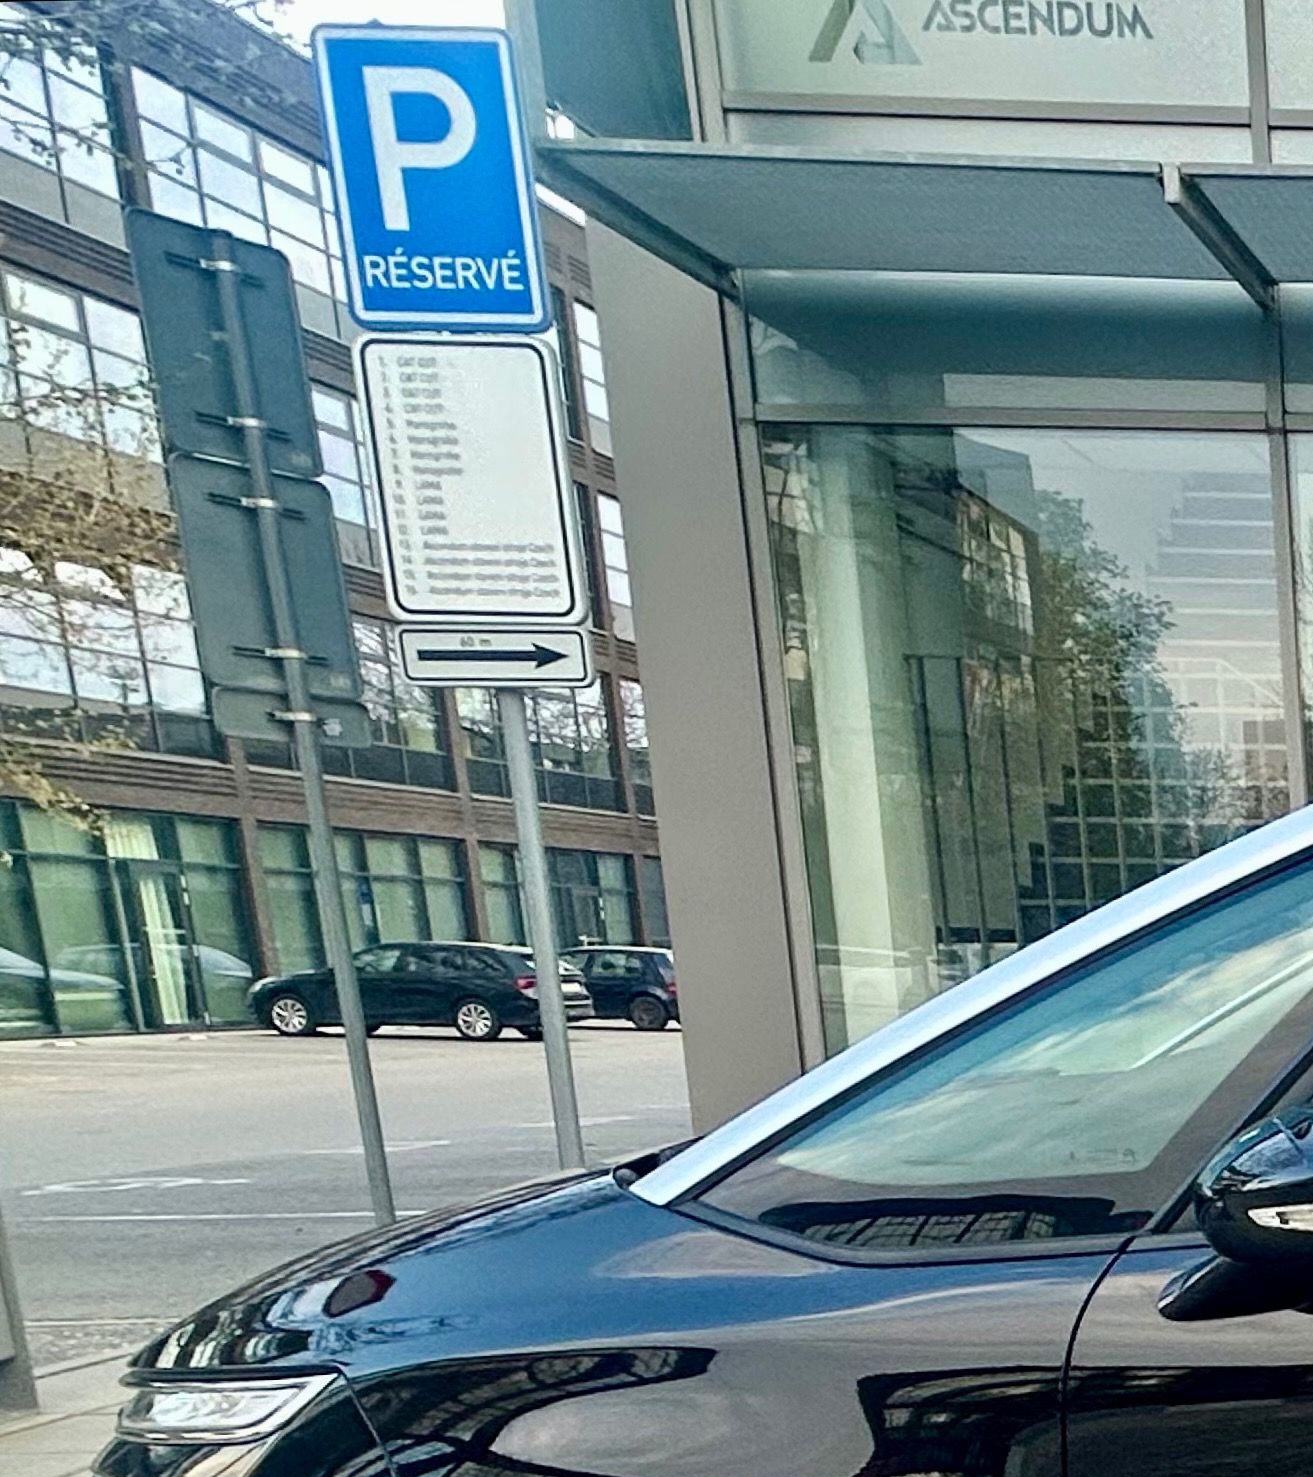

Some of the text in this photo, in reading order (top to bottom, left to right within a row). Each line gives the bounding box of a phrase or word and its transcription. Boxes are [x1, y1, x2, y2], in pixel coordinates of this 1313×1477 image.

[921, 0, 1154, 39] ASCENDUM
[362, 65, 477, 231] P
[362, 247, 525, 291] RÉSERVÉ
